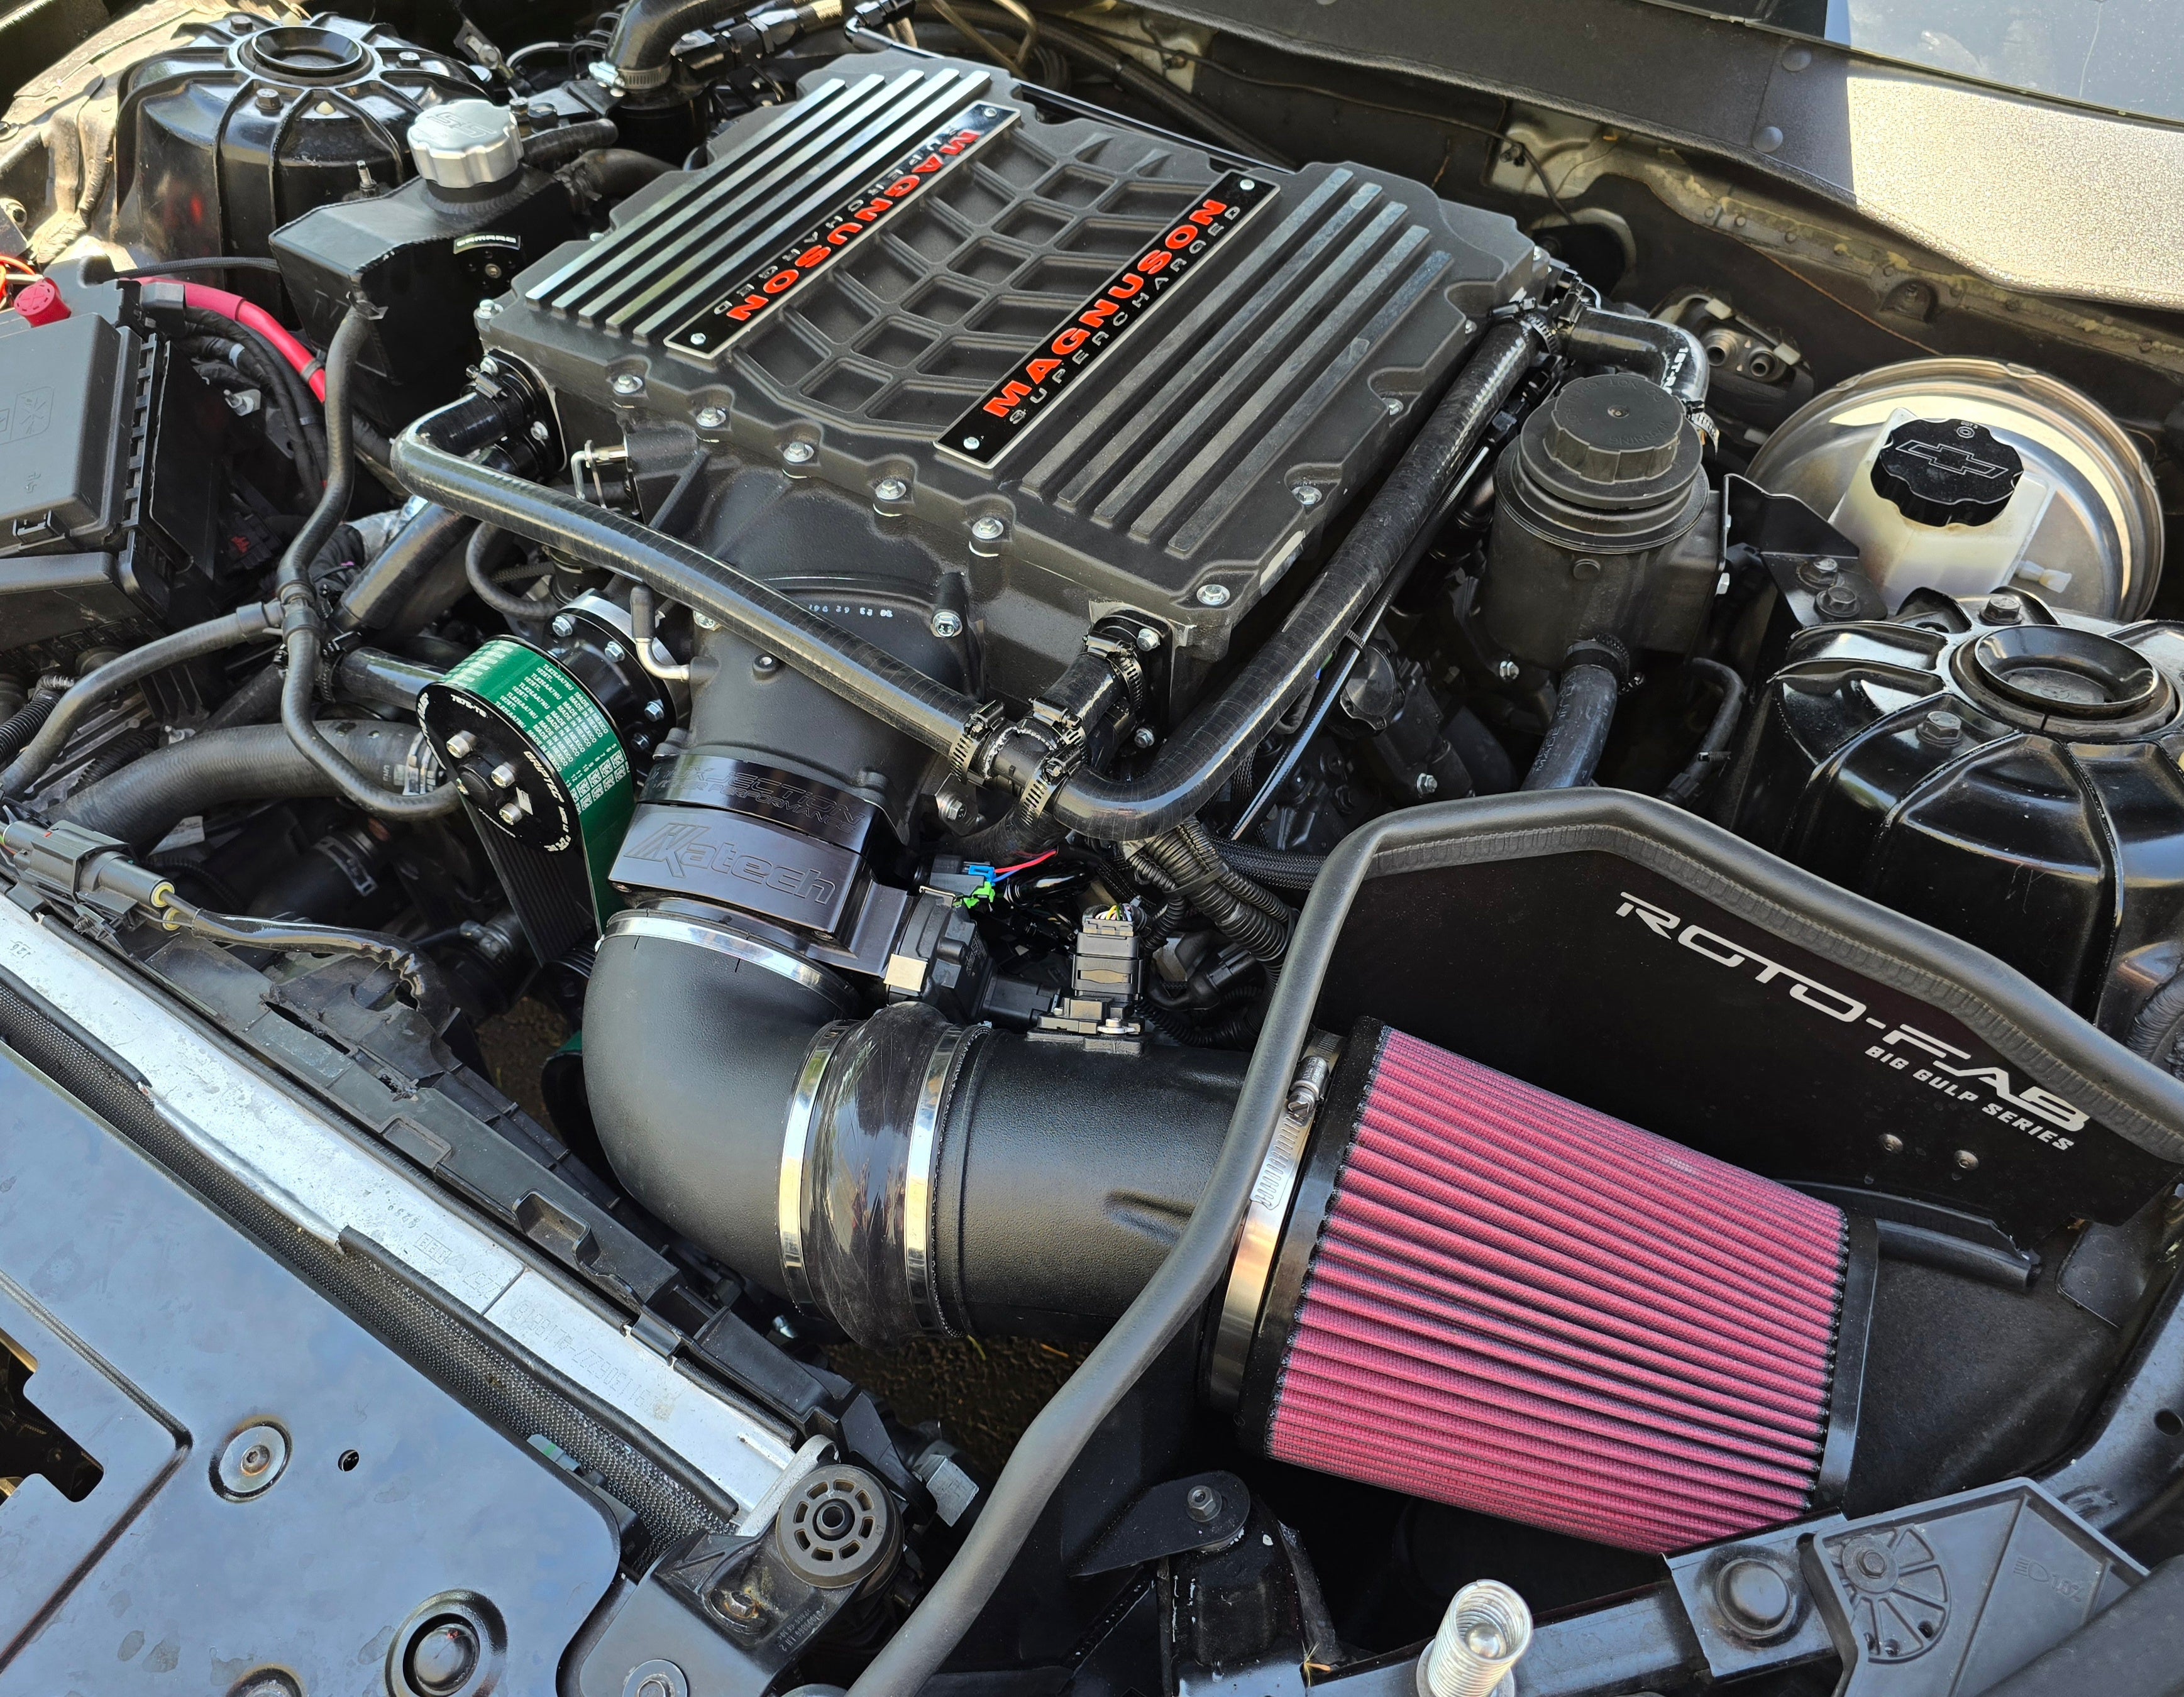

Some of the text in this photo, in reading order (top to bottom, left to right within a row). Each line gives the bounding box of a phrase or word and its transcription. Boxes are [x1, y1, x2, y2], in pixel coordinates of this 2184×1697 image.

[725, 129, 981, 322] MAGNUSON
[982, 199, 1227, 418] MAGNUSON
[1009, 206, 1241, 424] SUPERCHARGED
[551, 711, 566, 727] MADE
[569, 732, 585, 753] MEXICO
[556, 706, 571, 722] MADE
[575, 727, 591, 748] MEXICO
[562, 701, 577, 717] MADE
[580, 722, 597, 744] MEXICO
[568, 697, 583, 713] MADE
[587, 717, 603, 739] MEXICO
[574, 692, 589, 708] MADE
[592, 713, 609, 734] MEXICO
[527, 730, 543, 746] MADE
[546, 750, 562, 772] MEXICO
[533, 725, 548, 741] MADE
[551, 746, 568, 767] MEXICO
[539, 720, 554, 736] MADE
[557, 741, 573, 762] MEXICO
[545, 716, 560, 732] MADE
[563, 736, 580, 757] MEXICO
[523, 750, 565, 803] GRIPTEC
[709, 784, 858, 834] PERFORMANCE
[624, 822, 837, 906] Katech
[1614, 891, 2091, 1133] ROTO-FAB
[1865, 1045, 2075, 1151] BIG GULP SERIES
